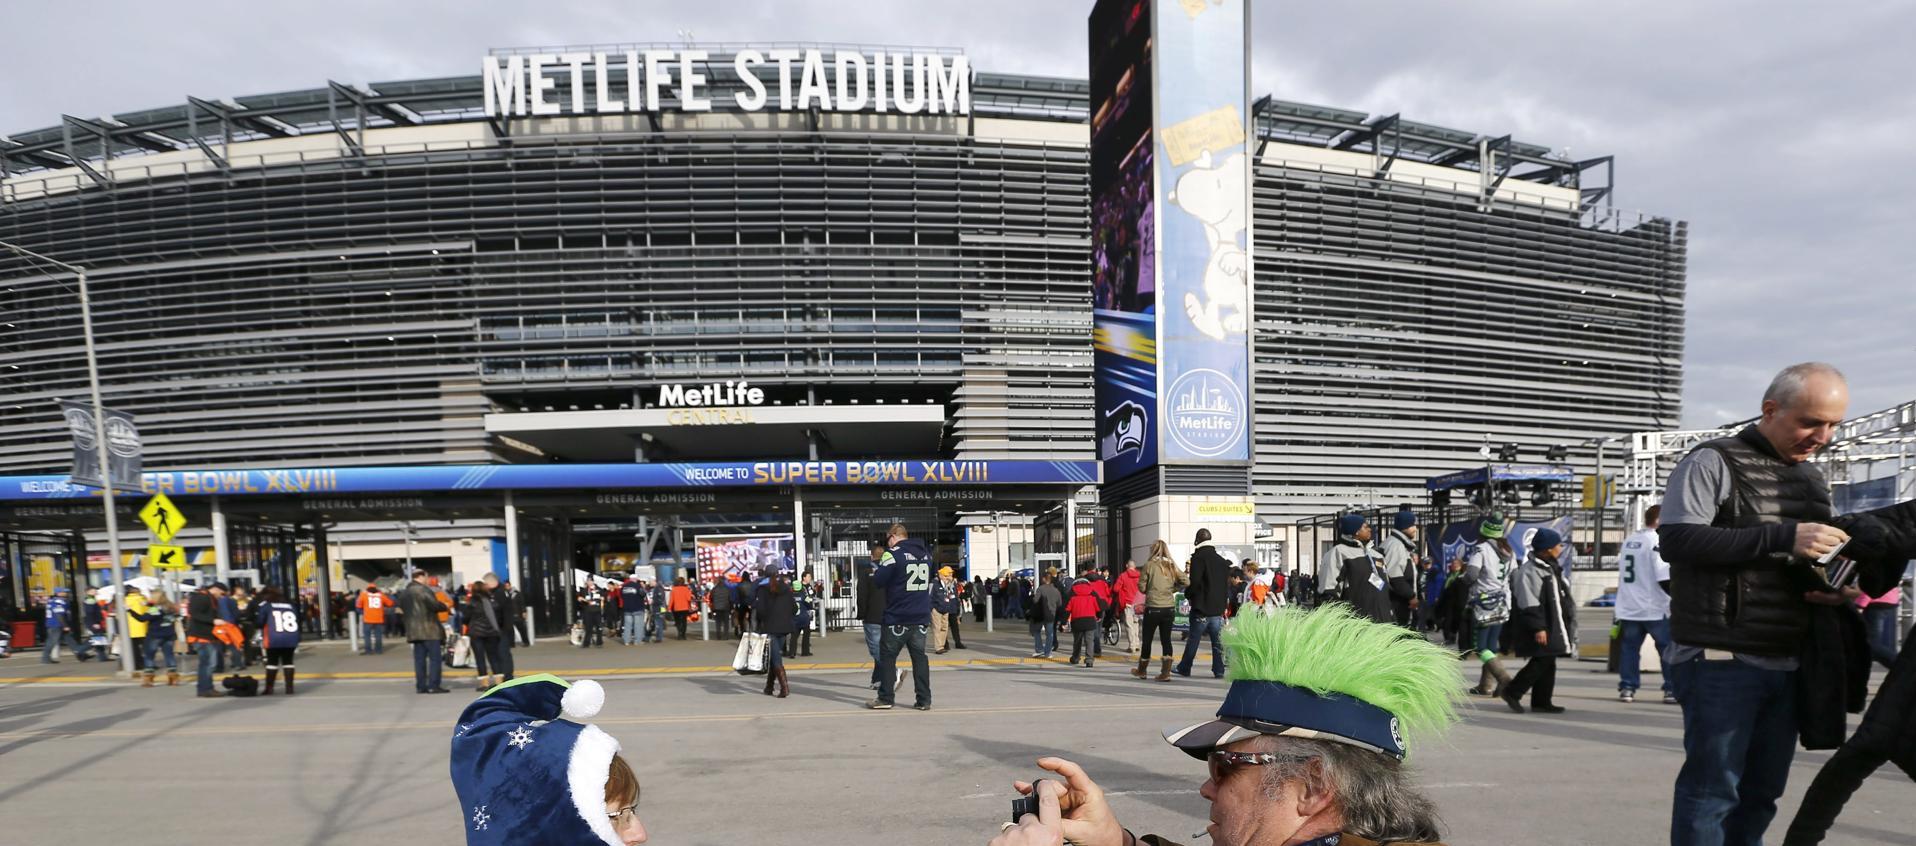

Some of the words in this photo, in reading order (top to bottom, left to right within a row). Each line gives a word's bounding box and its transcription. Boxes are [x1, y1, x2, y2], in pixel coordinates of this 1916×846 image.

[483, 51, 711, 116] METLIFE
[734, 49, 972, 115] STADIUM
[659, 381, 764, 407] MetLife
[667, 409, 754, 425] CENTRAL
[1180, 416, 1232, 430] MetLife
[183, 471, 258, 492] BOWL
[264, 469, 336, 491] XLVIII
[685, 468, 733, 480] WELCOME
[736, 467, 749, 479] TO
[753, 462, 837, 484] SUPER
[846, 461, 916, 483] BOWL
[921, 461, 988, 482] XLVIII
[303, 500, 355, 510] GENERAL
[359, 498, 423, 508] ADMISSION
[596, 496, 649, 504] GENERAL
[653, 493, 715, 503] ADMISSION
[881, 491, 930, 499] GENERAL
[934, 490, 993, 498] ADMISSION
[906, 563, 929, 591] 29
[1623, 555, 1635, 583] 3
[368, 597, 381, 608] 18
[271, 611, 298, 632] 18
